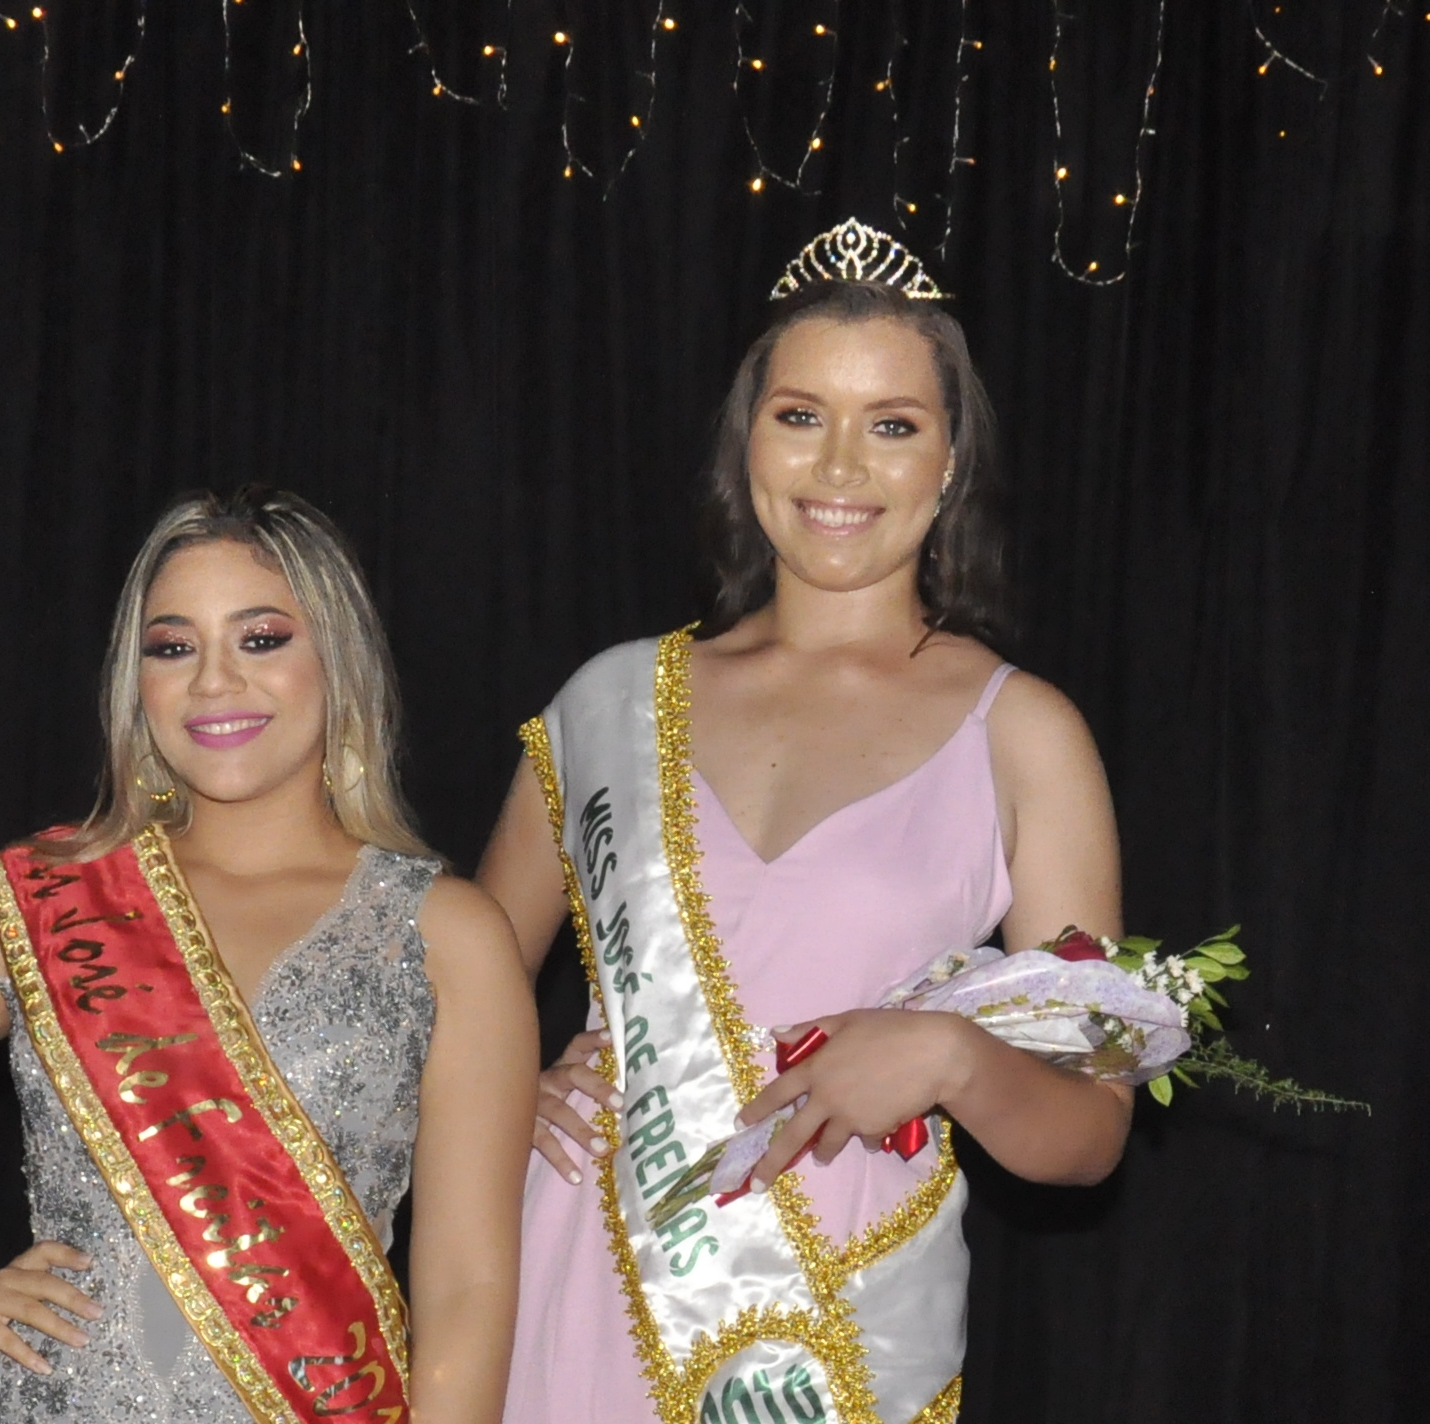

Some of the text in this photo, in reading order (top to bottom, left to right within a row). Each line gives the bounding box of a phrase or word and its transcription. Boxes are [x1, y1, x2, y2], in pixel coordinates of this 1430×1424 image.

[94, 1031, 198, 1104] de
[578, 785, 618, 901] MISS
[626, 1086, 721, 1279] FREIAS
[137, 1097, 300, 1329] Freitas
